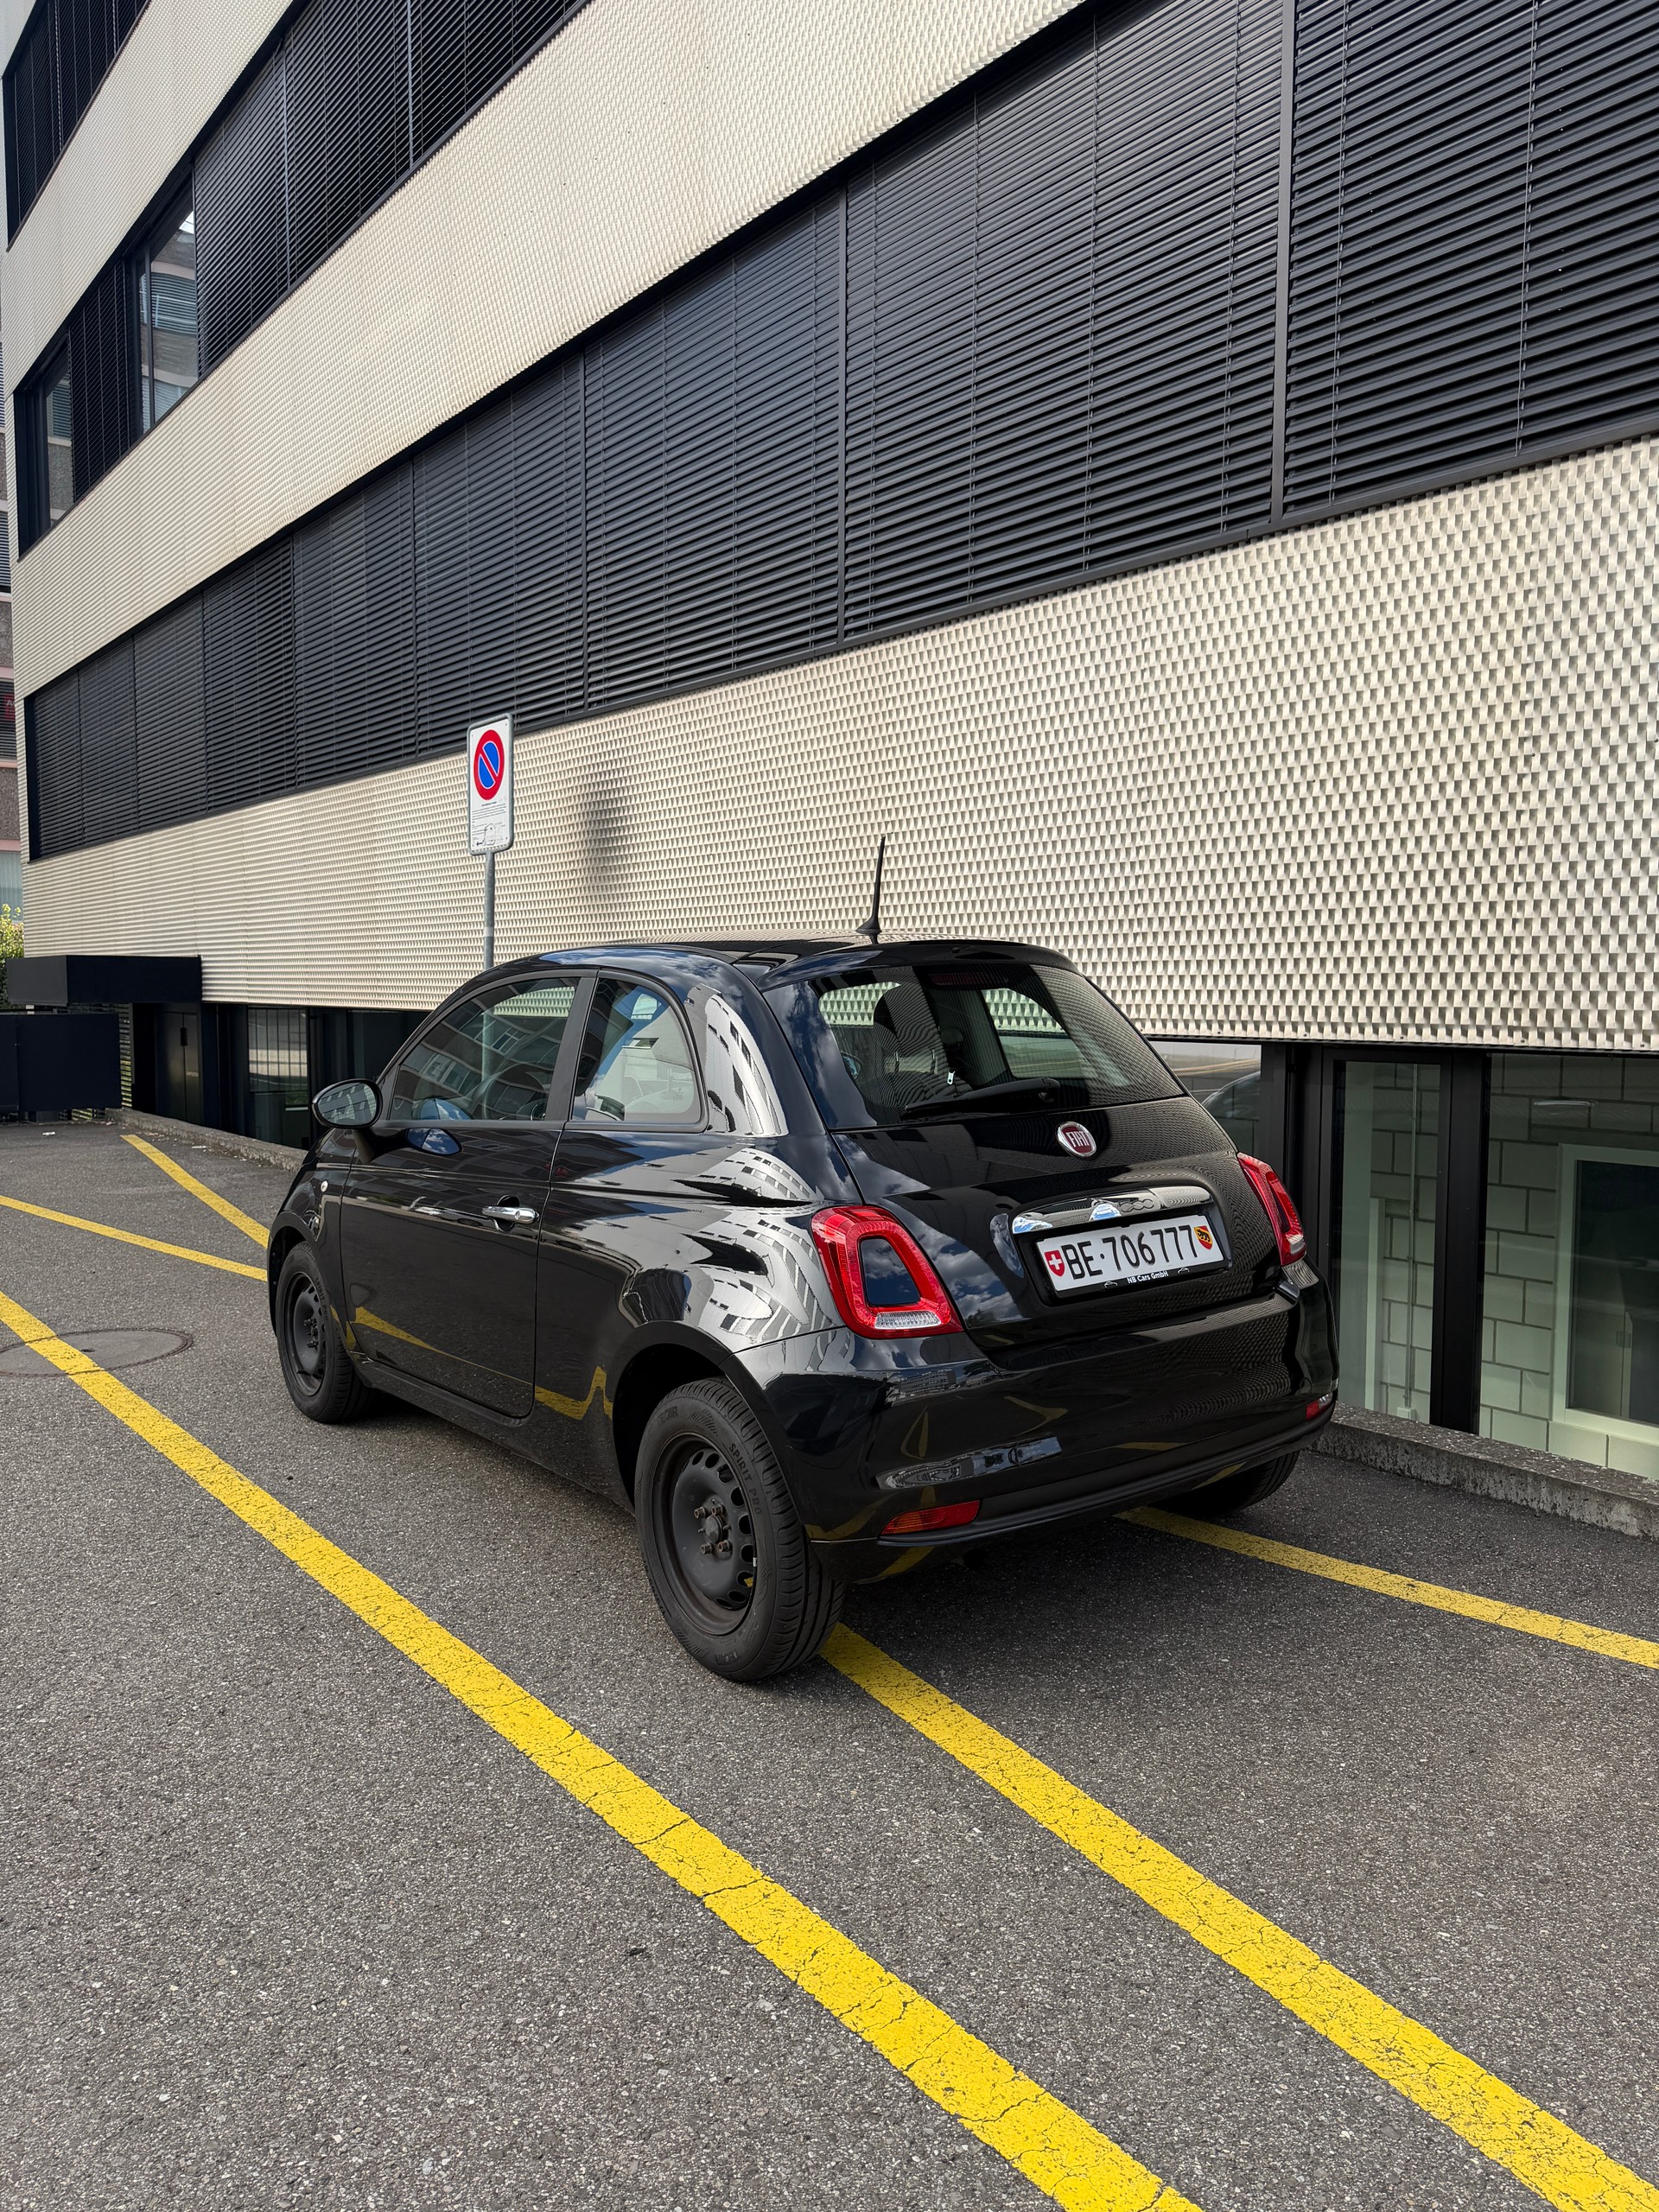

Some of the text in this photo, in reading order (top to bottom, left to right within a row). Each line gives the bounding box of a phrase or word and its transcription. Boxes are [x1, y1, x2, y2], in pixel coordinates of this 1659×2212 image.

[1065, 1130, 1090, 1147] FIAT
[1137, 1273, 1151, 1282] Cars
[1151, 1270, 1169, 1280] GmbH
[315, 1277, 325, 1300] SPIRIT
[729, 1443, 762, 1515] SPIRIT PRO
